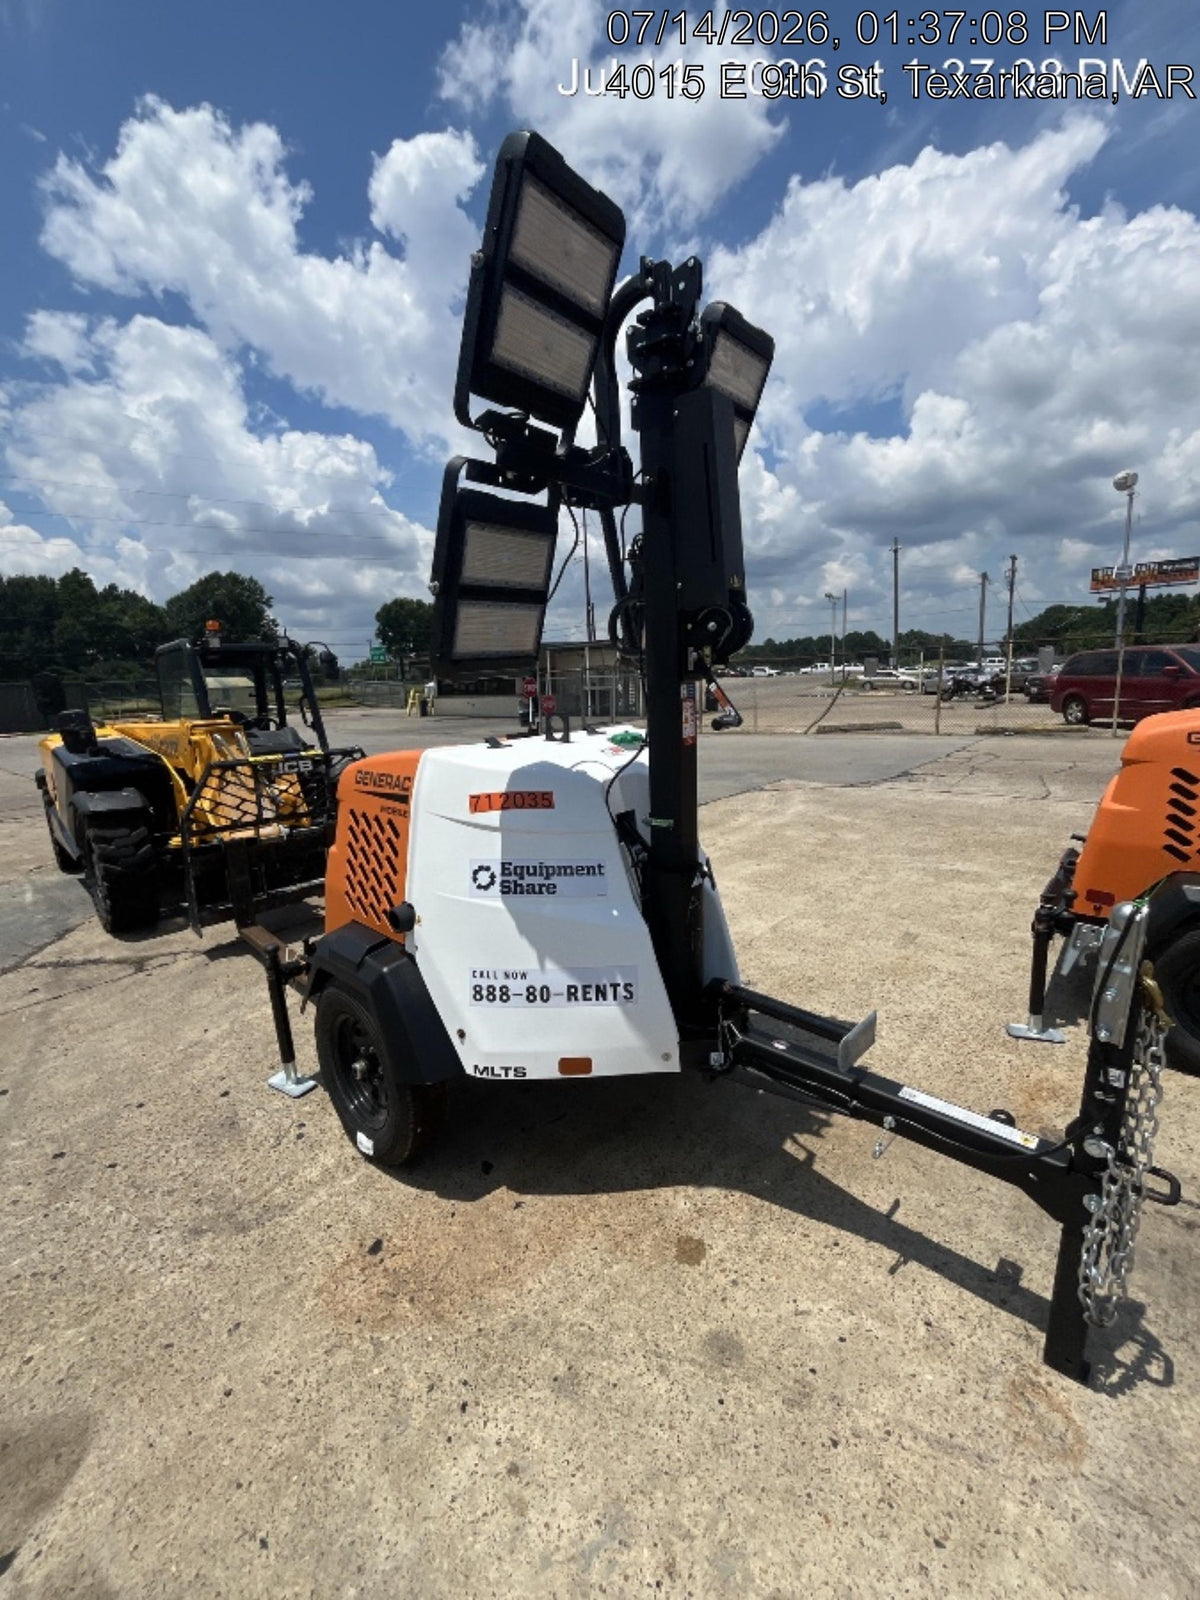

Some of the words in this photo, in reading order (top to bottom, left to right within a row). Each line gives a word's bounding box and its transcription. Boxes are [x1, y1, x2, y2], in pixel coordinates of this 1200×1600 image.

[355, 770, 411, 791] GENERAC
[470, 792, 552, 812] 712035
[500, 862, 605, 880] Equipment
[500, 880, 557, 895] Share
[472, 970, 498, 980] CALL
[504, 971, 529, 980] NOW
[472, 982, 634, 1003] 888-80-RENTS
[473, 1064, 527, 1078] MLTS
